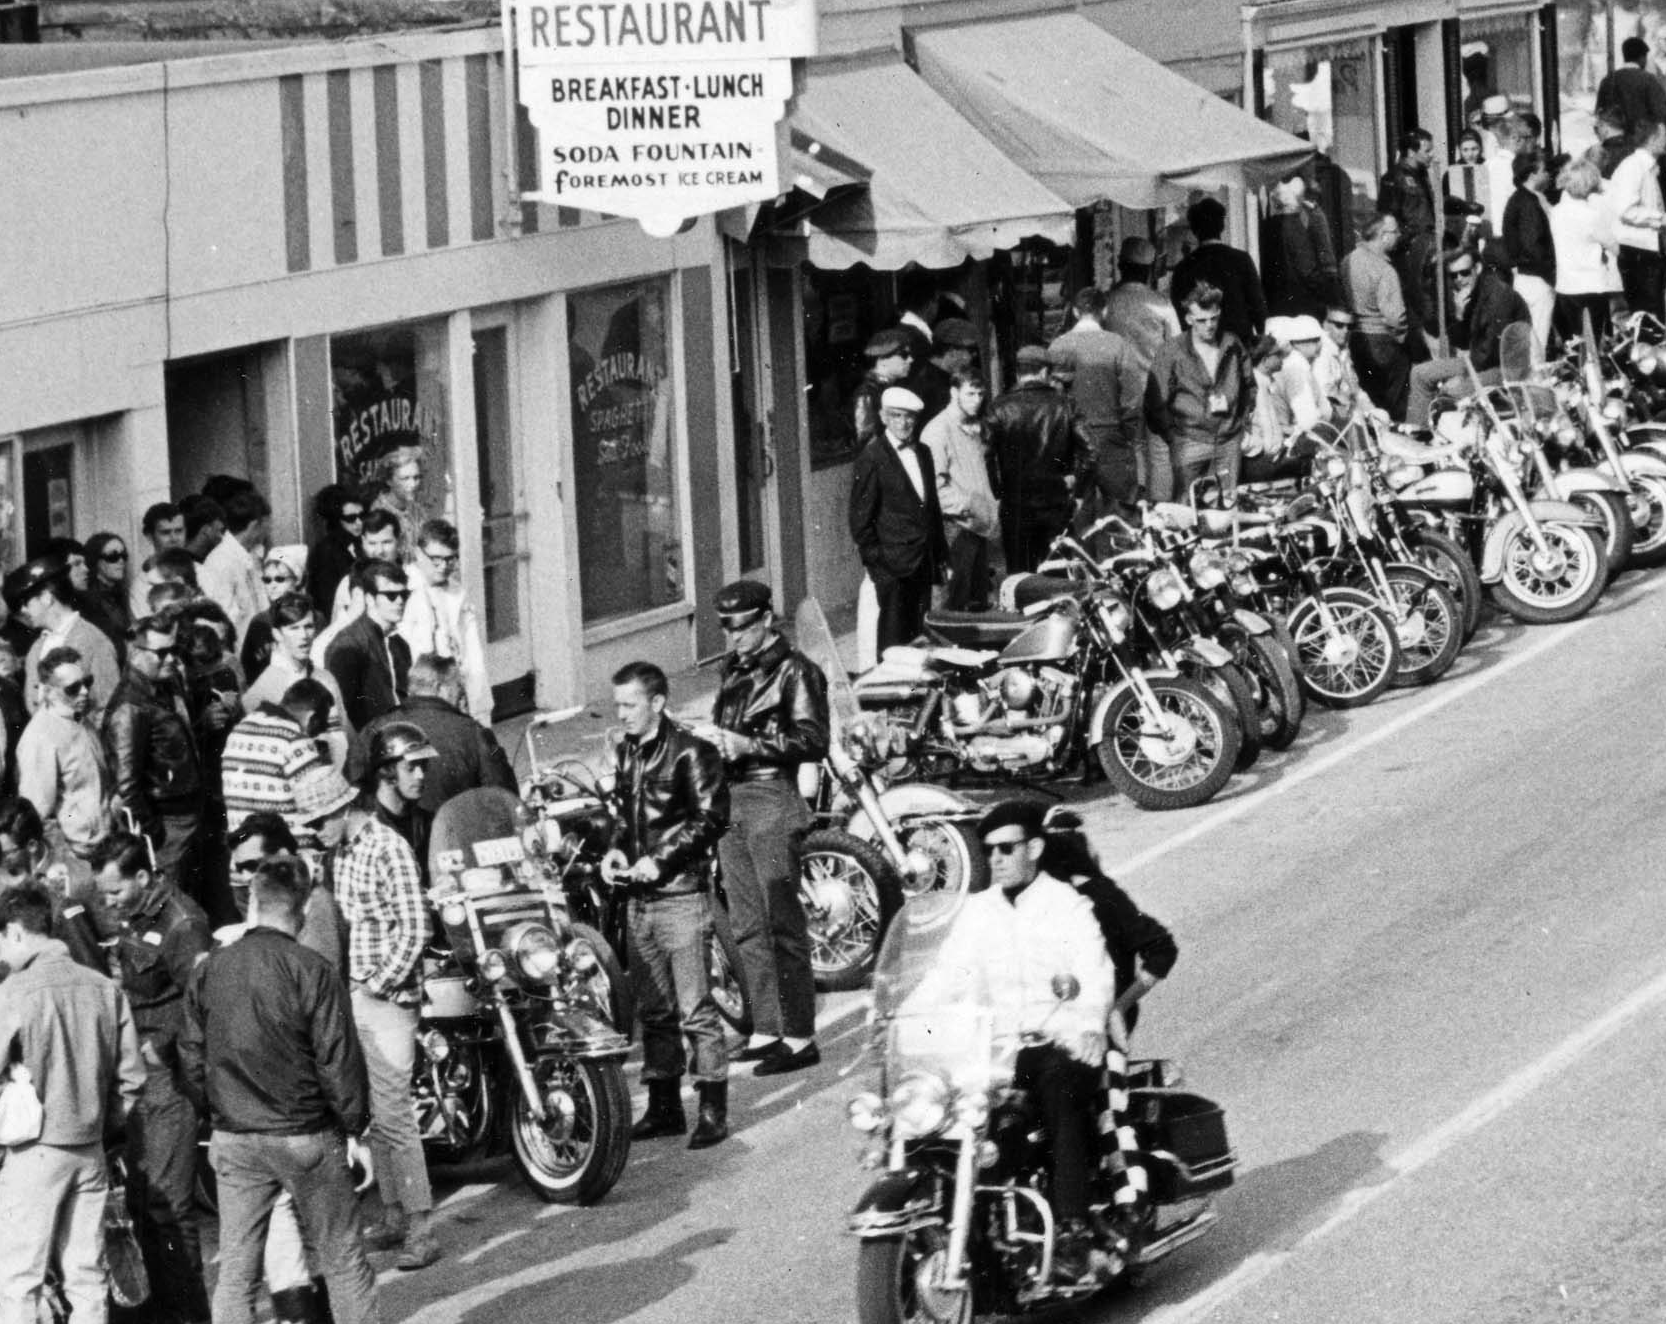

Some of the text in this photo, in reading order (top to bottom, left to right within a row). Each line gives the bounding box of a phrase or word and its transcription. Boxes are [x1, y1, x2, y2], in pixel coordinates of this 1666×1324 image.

[531, 0, 771, 48] RESTAURANT
[552, 73, 765, 103] BREAKFAST LUNCH
[607, 105, 701, 131] DINNER
[553, 144, 619, 164] SODA
[678, 172, 701, 186] ICE
[705, 169, 764, 185] CREAM
